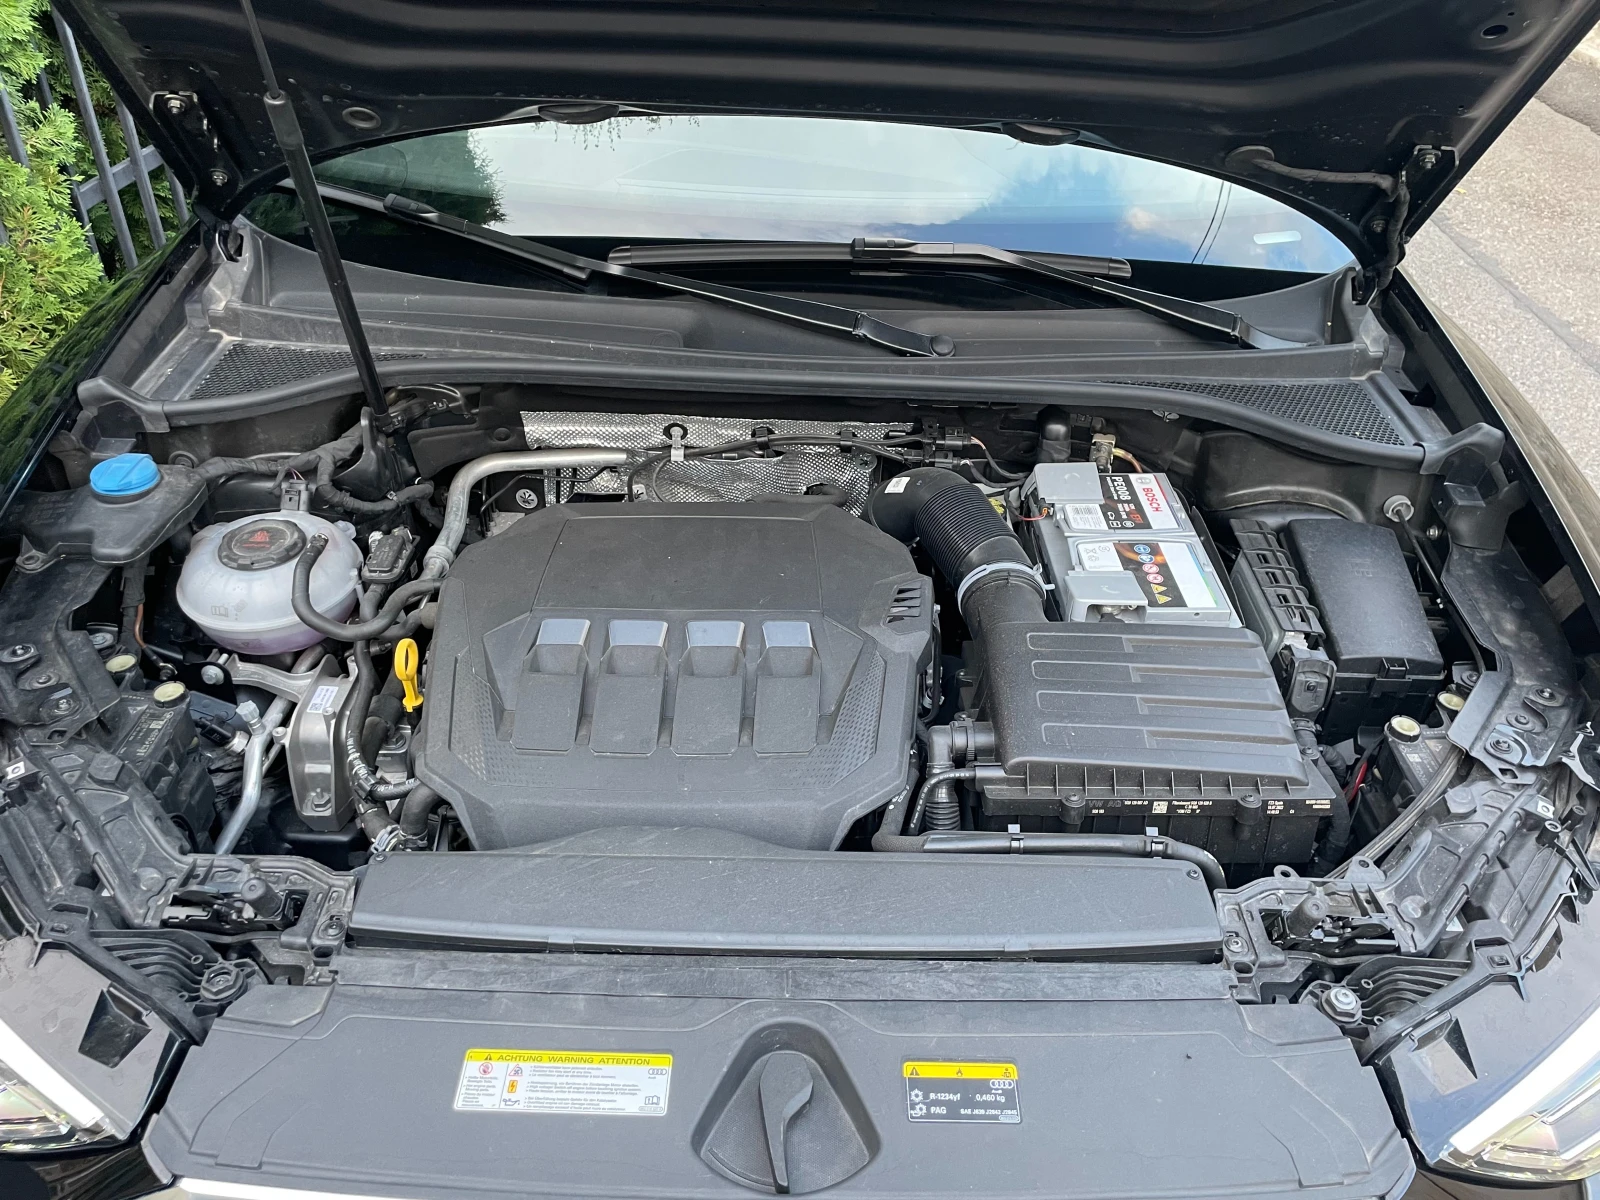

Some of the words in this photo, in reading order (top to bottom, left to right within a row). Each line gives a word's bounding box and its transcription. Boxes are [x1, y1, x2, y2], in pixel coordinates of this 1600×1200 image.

[1112, 476, 1131, 500] PE008
[1142, 487, 1163, 512] BOSCH
[497, 1054, 543, 1063] ACHTUNG
[548, 1056, 594, 1064] WARNING
[599, 1057, 651, 1065] ATTENTION
[929, 1092, 961, 1102] R-1234yf
[996, 1094, 1006, 1103] kg
[930, 1106, 947, 1114] PAG
